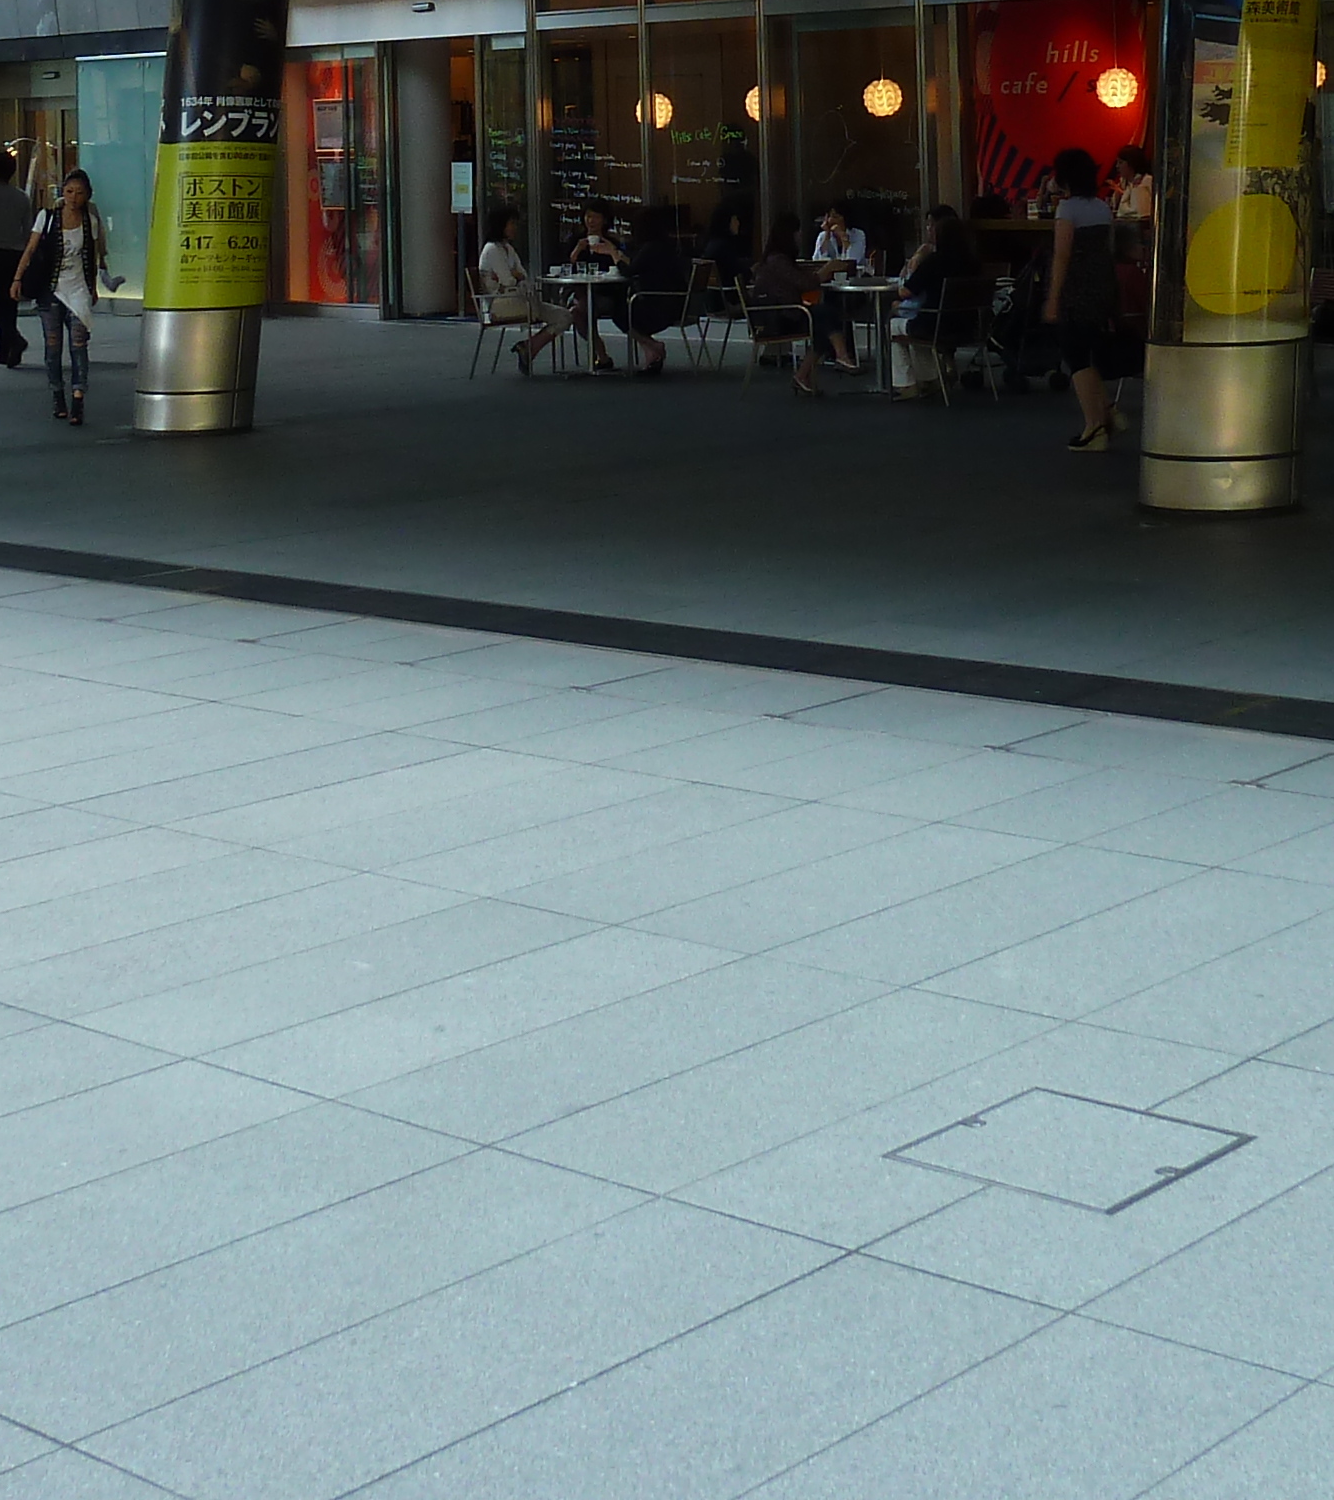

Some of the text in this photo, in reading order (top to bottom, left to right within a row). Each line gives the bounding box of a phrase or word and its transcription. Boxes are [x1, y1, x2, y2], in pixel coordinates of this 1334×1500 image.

[1045, 40, 1099, 64] hills
[186, 178, 261, 197] ボストン
[185, 201, 261, 220] 美術館展
